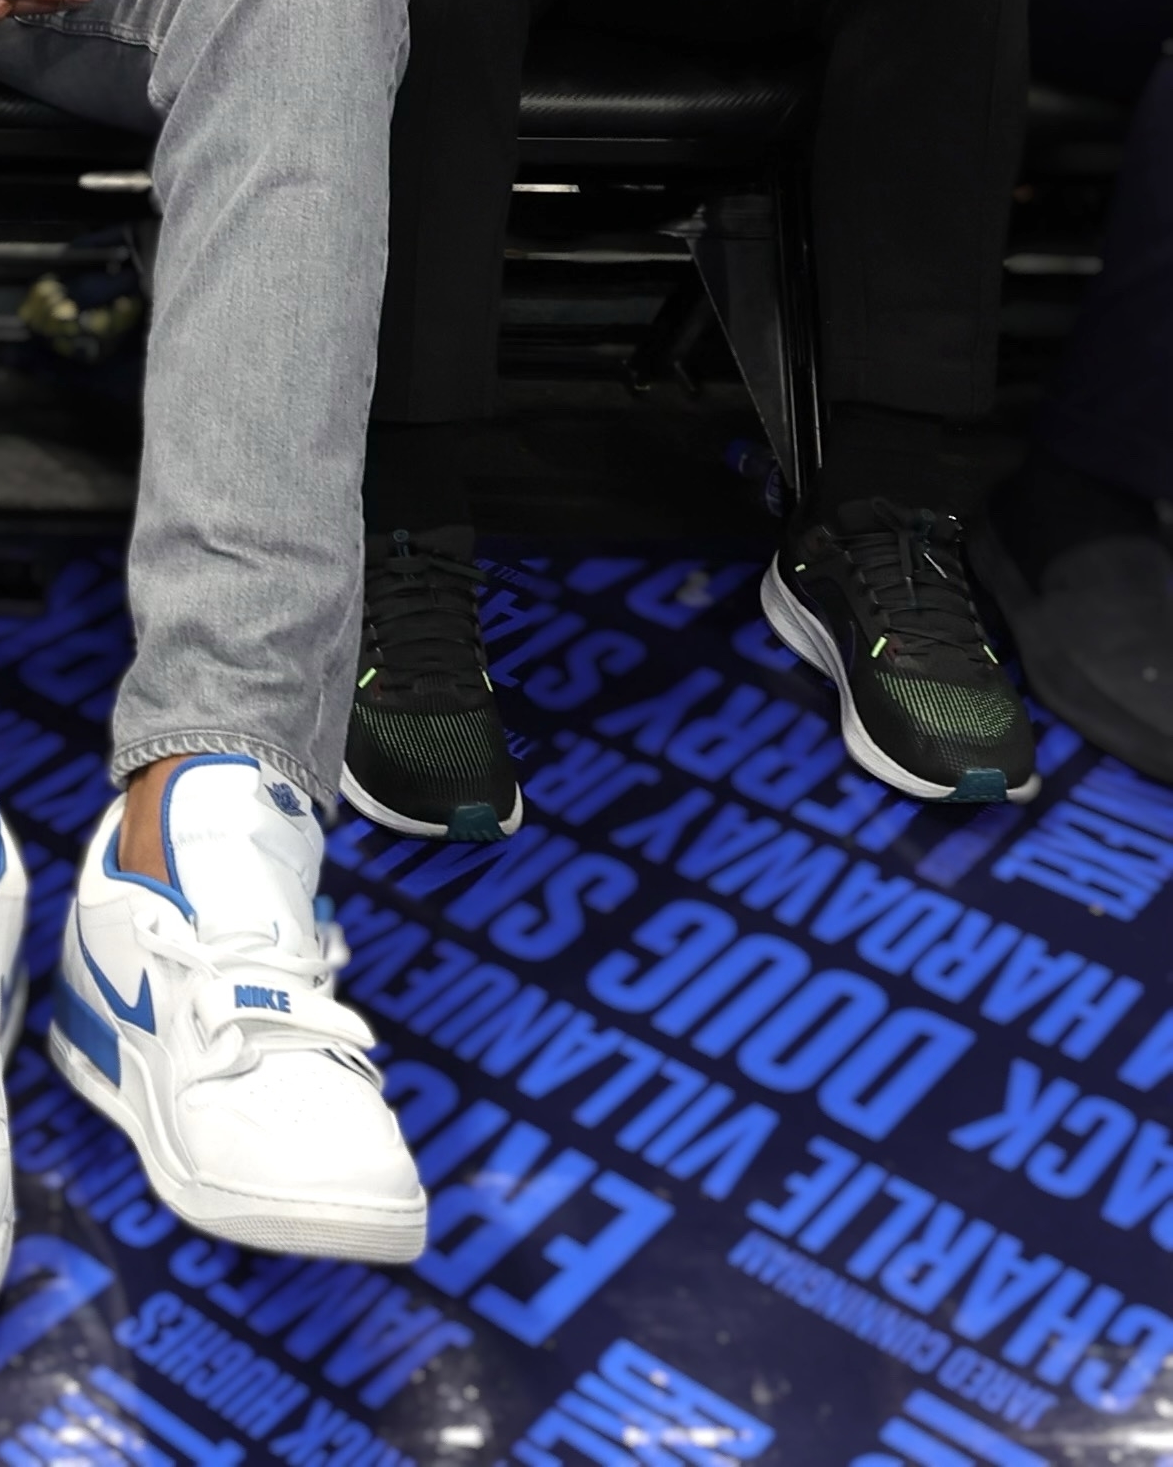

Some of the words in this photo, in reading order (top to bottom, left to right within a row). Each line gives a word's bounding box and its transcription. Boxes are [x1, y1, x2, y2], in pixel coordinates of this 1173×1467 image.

[509, 728, 669, 833] JR.
[233, 984, 293, 1014] NIKE
[601, 784, 1148, 1065] HARDAWAY
[568, 889, 982, 1144] DOUG
[942, 1054, 1173, 1253] ACK
[720, 1225, 957, 1377] CUNNINGHAM
[739, 1132, 1173, 1426] CHARLIE
[105, 1284, 315, 1443] HUGHES
[934, 1338, 1062, 1436] JARED
